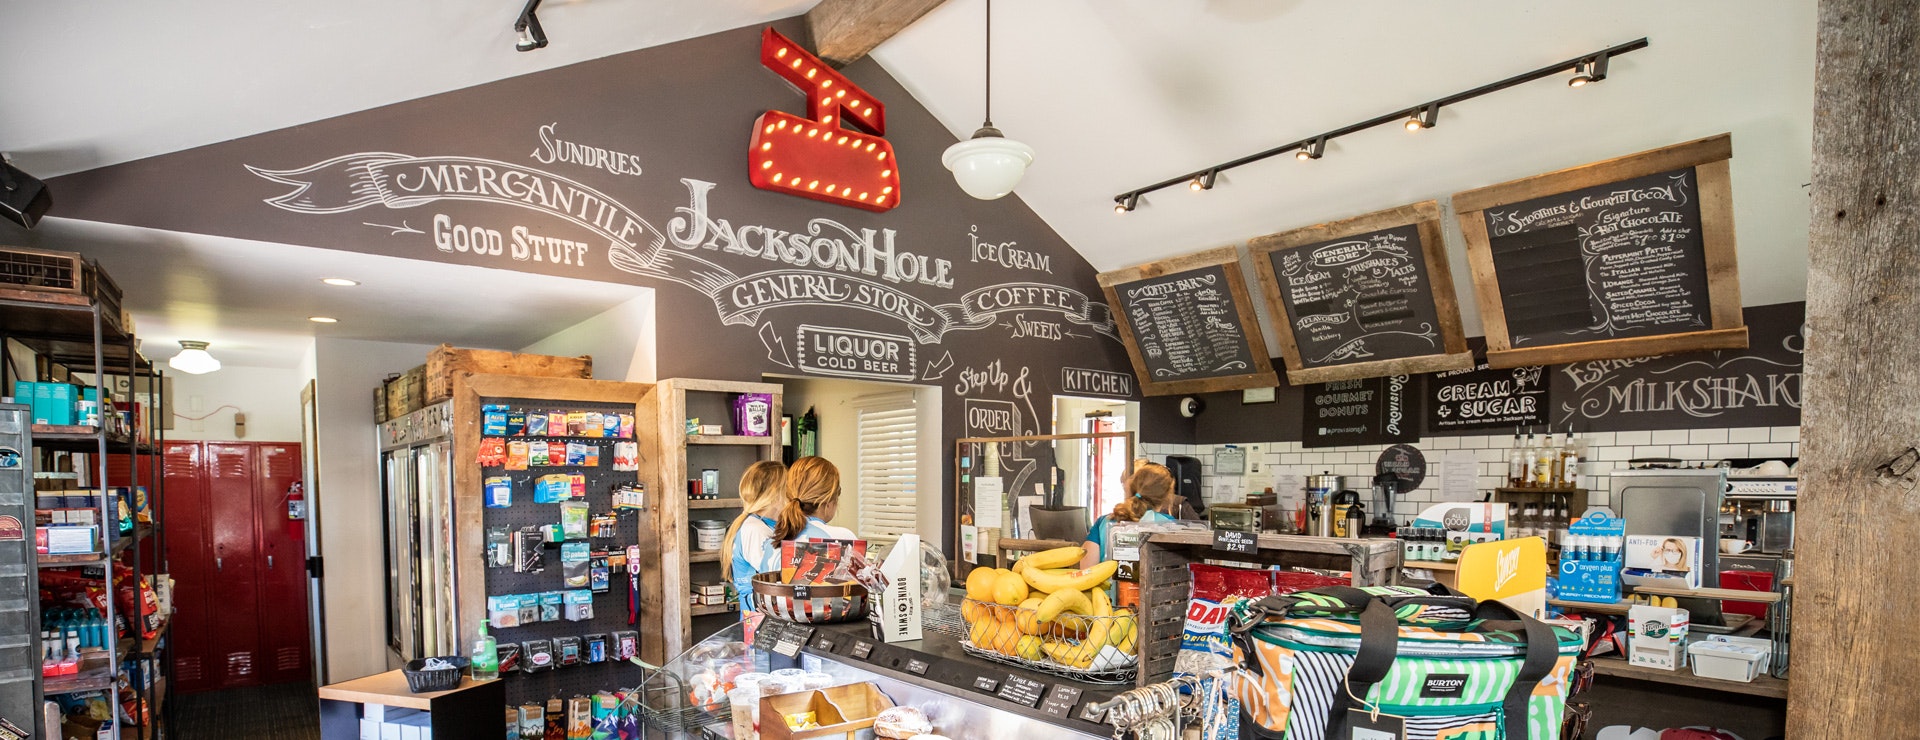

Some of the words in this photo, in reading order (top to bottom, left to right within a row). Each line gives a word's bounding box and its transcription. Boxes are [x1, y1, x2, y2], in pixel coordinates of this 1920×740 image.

[530, 122, 642, 177] SUNDRIES
[396, 164, 643, 248] MERCANTILE
[1507, 203, 1567, 234] SMOOTHIES
[1569, 201, 1580, 213] &
[1580, 189, 1634, 210] GOURMET
[1632, 185, 1677, 201] COCOA
[1603, 206, 1651, 224] Signature
[1597, 222, 1619, 235] HOT
[1620, 212, 1684, 228] CHOCOLATE
[433, 213, 503, 256] GOOD
[511, 225, 588, 266] STUFF
[997, 241, 1054, 274] CREAM
[1315, 243, 1366, 259] GENERAL
[1324, 251, 1360, 264] STORE
[1602, 249, 1644, 262] PEPPERMINT
[1644, 246, 1673, 256] PATTIE
[1288, 277, 1306, 286] ICE
[1305, 271, 1331, 283] CREAM
[1343, 257, 1399, 278] MILKSHAKES
[1384, 264, 1416, 277] MALTS
[1611, 267, 1640, 276] ITALIAN
[1142, 282, 1177, 297] COFFEE
[1179, 277, 1202, 291] BAR
[731, 275, 852, 309] GENERAL
[853, 284, 936, 326] STORE
[977, 287, 1075, 311] COFFEE
[1012, 313, 1062, 341] SWEETS
[813, 333, 900, 361] LIQUOR
[817, 355, 860, 372] COLD
[864, 360, 899, 374] BEER
[1436, 371, 1448, 379] WE
[1449, 367, 1475, 377] PROUDLY
[1477, 363, 1490, 371] SER
[955, 366, 987, 396] Step
[987, 359, 1009, 393] Up
[1066, 372, 1129, 394] KITCHEN
[1325, 378, 1363, 392] FRESH
[1315, 390, 1374, 405] GOURMET
[1437, 380, 1511, 402] CREAM
[1581, 373, 1804, 418] MILKSHAK
[1320, 404, 1369, 418] DONUTS
[1438, 405, 1451, 418] +
[1460, 396, 1537, 418] SUGAR
[969, 407, 1013, 434] ORDER
[1445, 516, 1468, 527] good
[1225, 531, 1242, 539] DAVID
[571, 551, 588, 559] patch
[1580, 564, 1599, 572] oxygen
[1600, 564, 1613, 572] plus
[897, 577, 908, 601] BOVINE
[1187, 601, 1231, 625] DAV
[899, 613, 909, 636] SWINE
